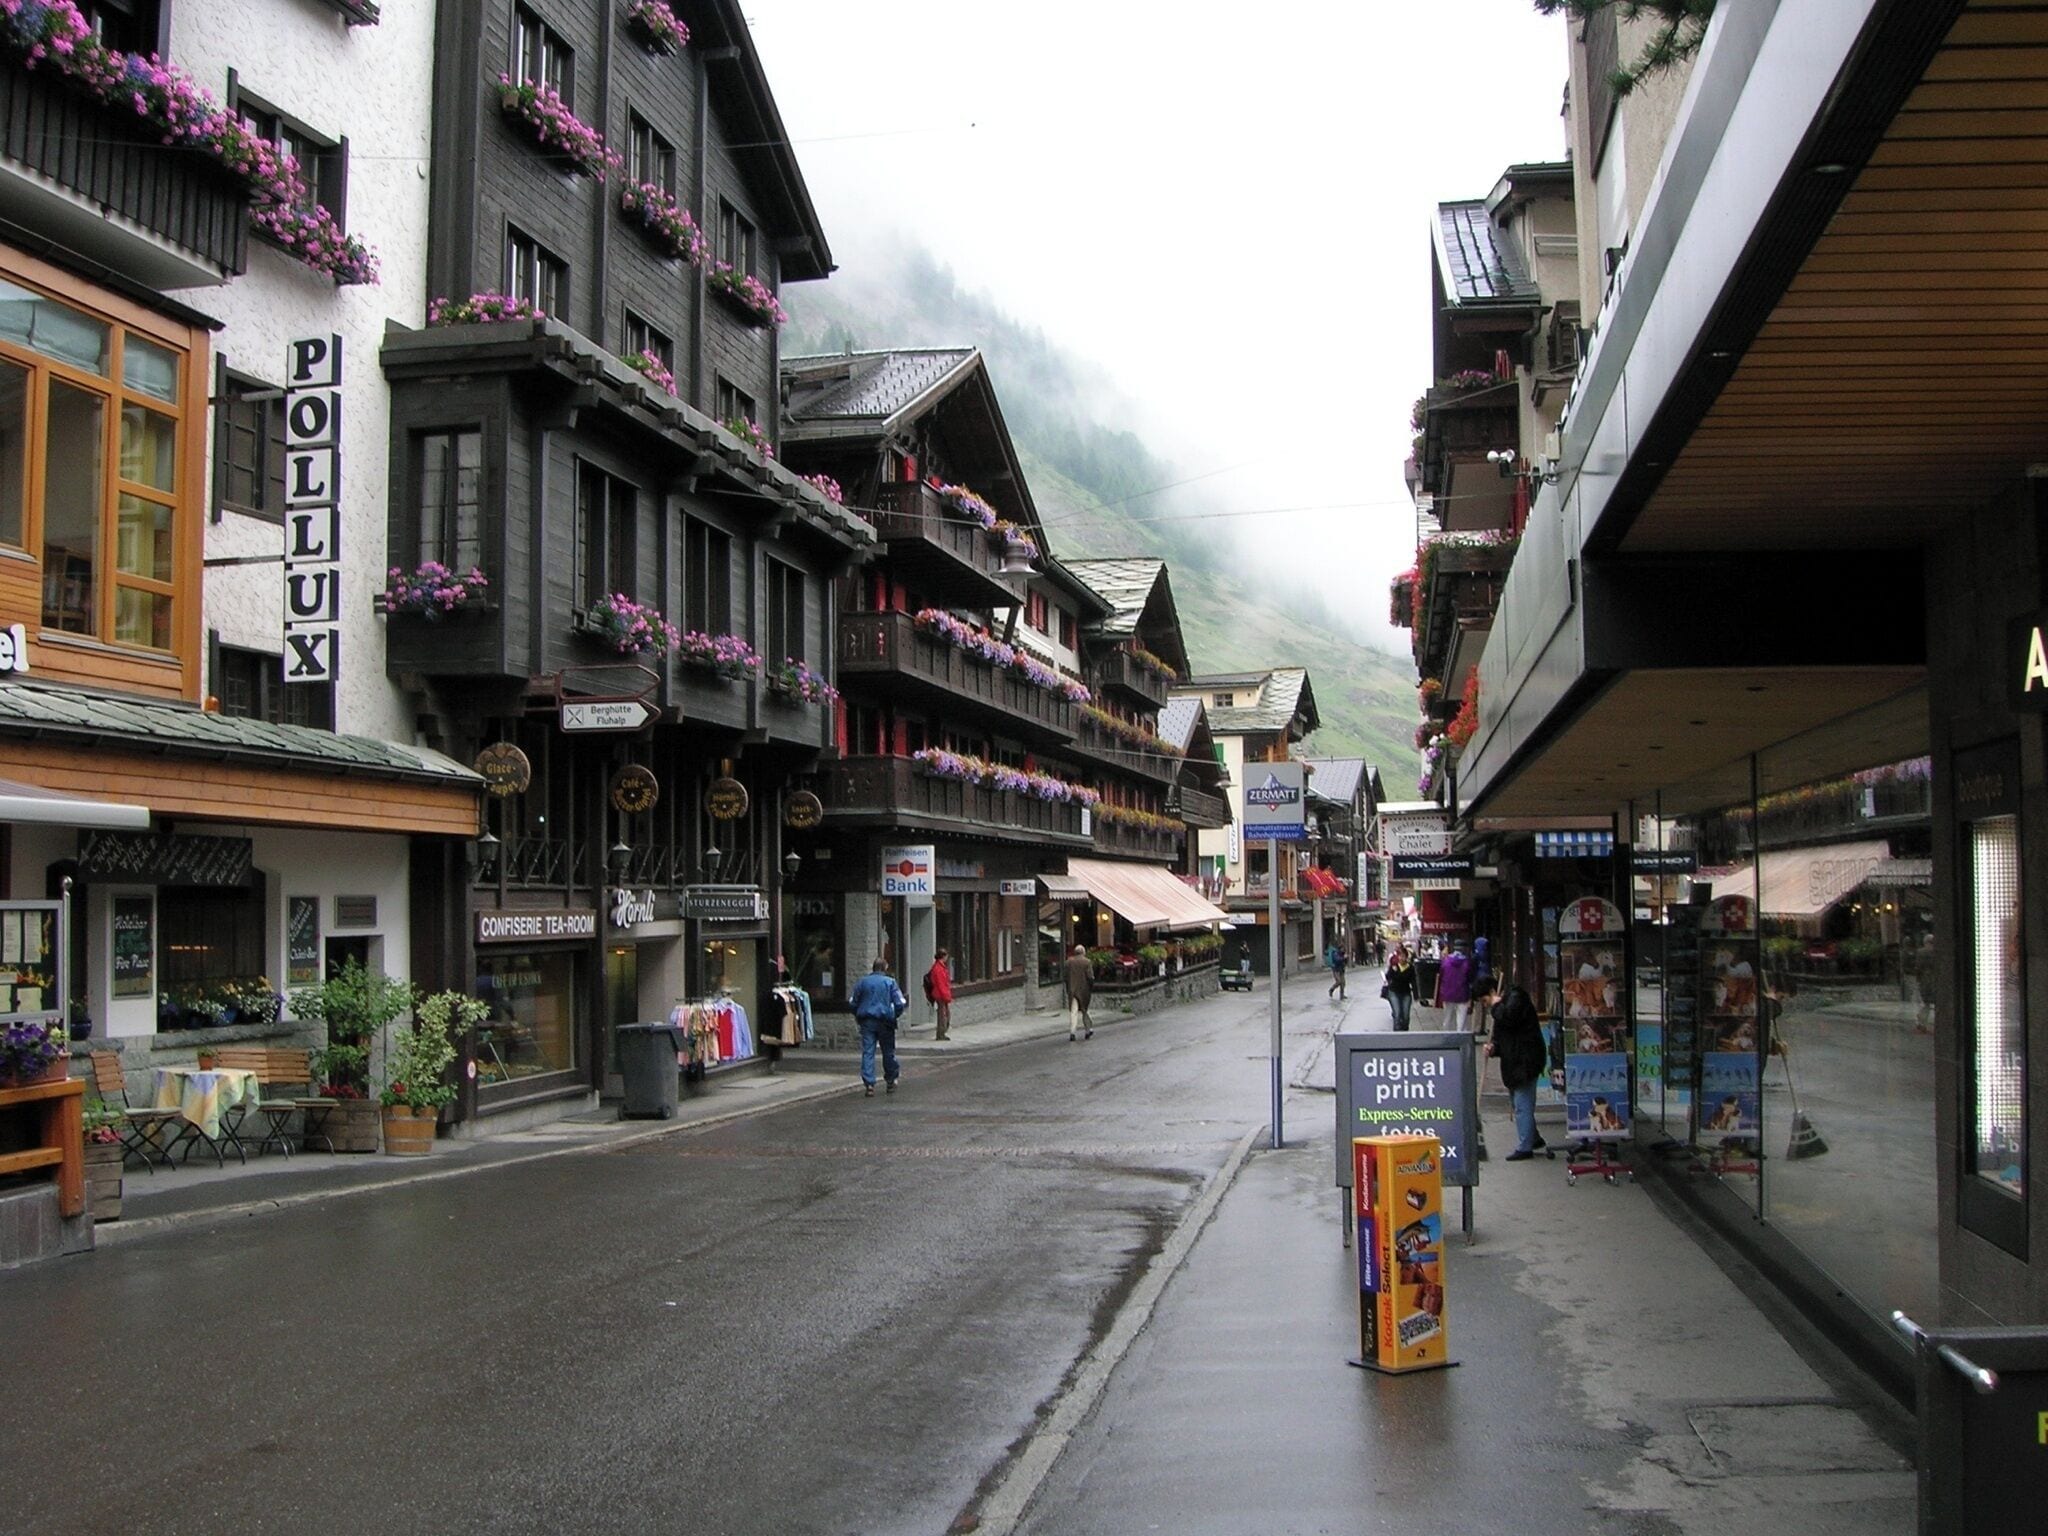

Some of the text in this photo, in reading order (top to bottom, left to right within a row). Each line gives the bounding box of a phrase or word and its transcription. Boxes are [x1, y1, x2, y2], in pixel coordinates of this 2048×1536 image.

[288, 337, 329, 678] POLLUX
[590, 704, 632, 716] Berghütte
[596, 715, 627, 726] Fluhalp
[1249, 790, 1297, 801] ZERMATT
[1390, 821, 1440, 835] Restaurant
[1399, 839, 1433, 849] Chalet
[885, 847, 928, 858] Raiffeisen
[1398, 861, 1470, 869] TOM TAILOR
[885, 879, 928, 893] Bank
[612, 889, 656, 929] Hörnli
[688, 898, 756, 908] STURZENEGGER
[481, 914, 595, 937] CONFISERIE TEA-ROOM
[1363, 1057, 1445, 1080] digital
[1376, 1079, 1436, 1103] print
[1359, 1107, 1454, 1123] Express-Service
[1380, 1124, 1436, 1138] fotos
[1439, 1145, 1457, 1158] ex
[1364, 1264, 1372, 1287] Elite
[1383, 1246, 1392, 1294] Select
[1384, 1296, 1393, 1348] Kodak
